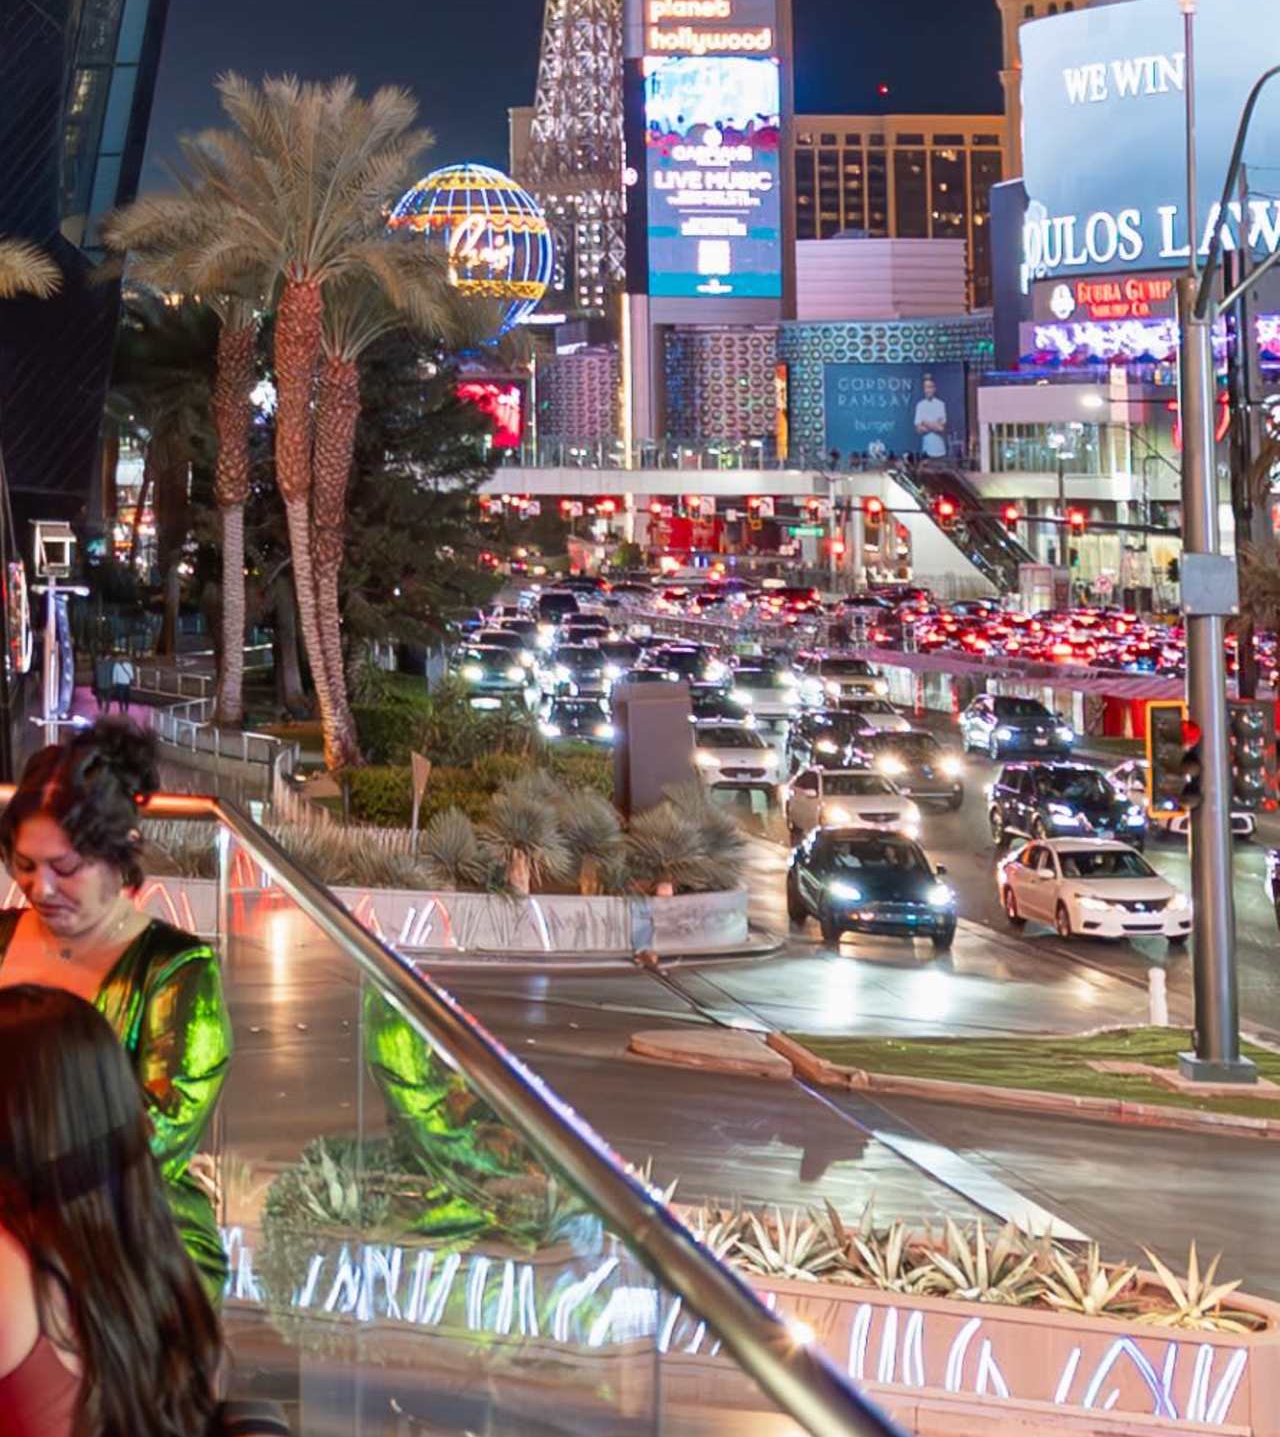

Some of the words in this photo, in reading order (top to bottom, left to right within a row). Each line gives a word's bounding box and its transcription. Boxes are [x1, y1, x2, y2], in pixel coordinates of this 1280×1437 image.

[649, 28, 772, 54] hollywood
[1063, 64, 1108, 105] WE
[1113, 52, 1186, 99] WIN
[654, 171, 702, 190] LIVE
[837, 377, 913, 391] GORDON
[837, 394, 912, 408] RAMSAY
